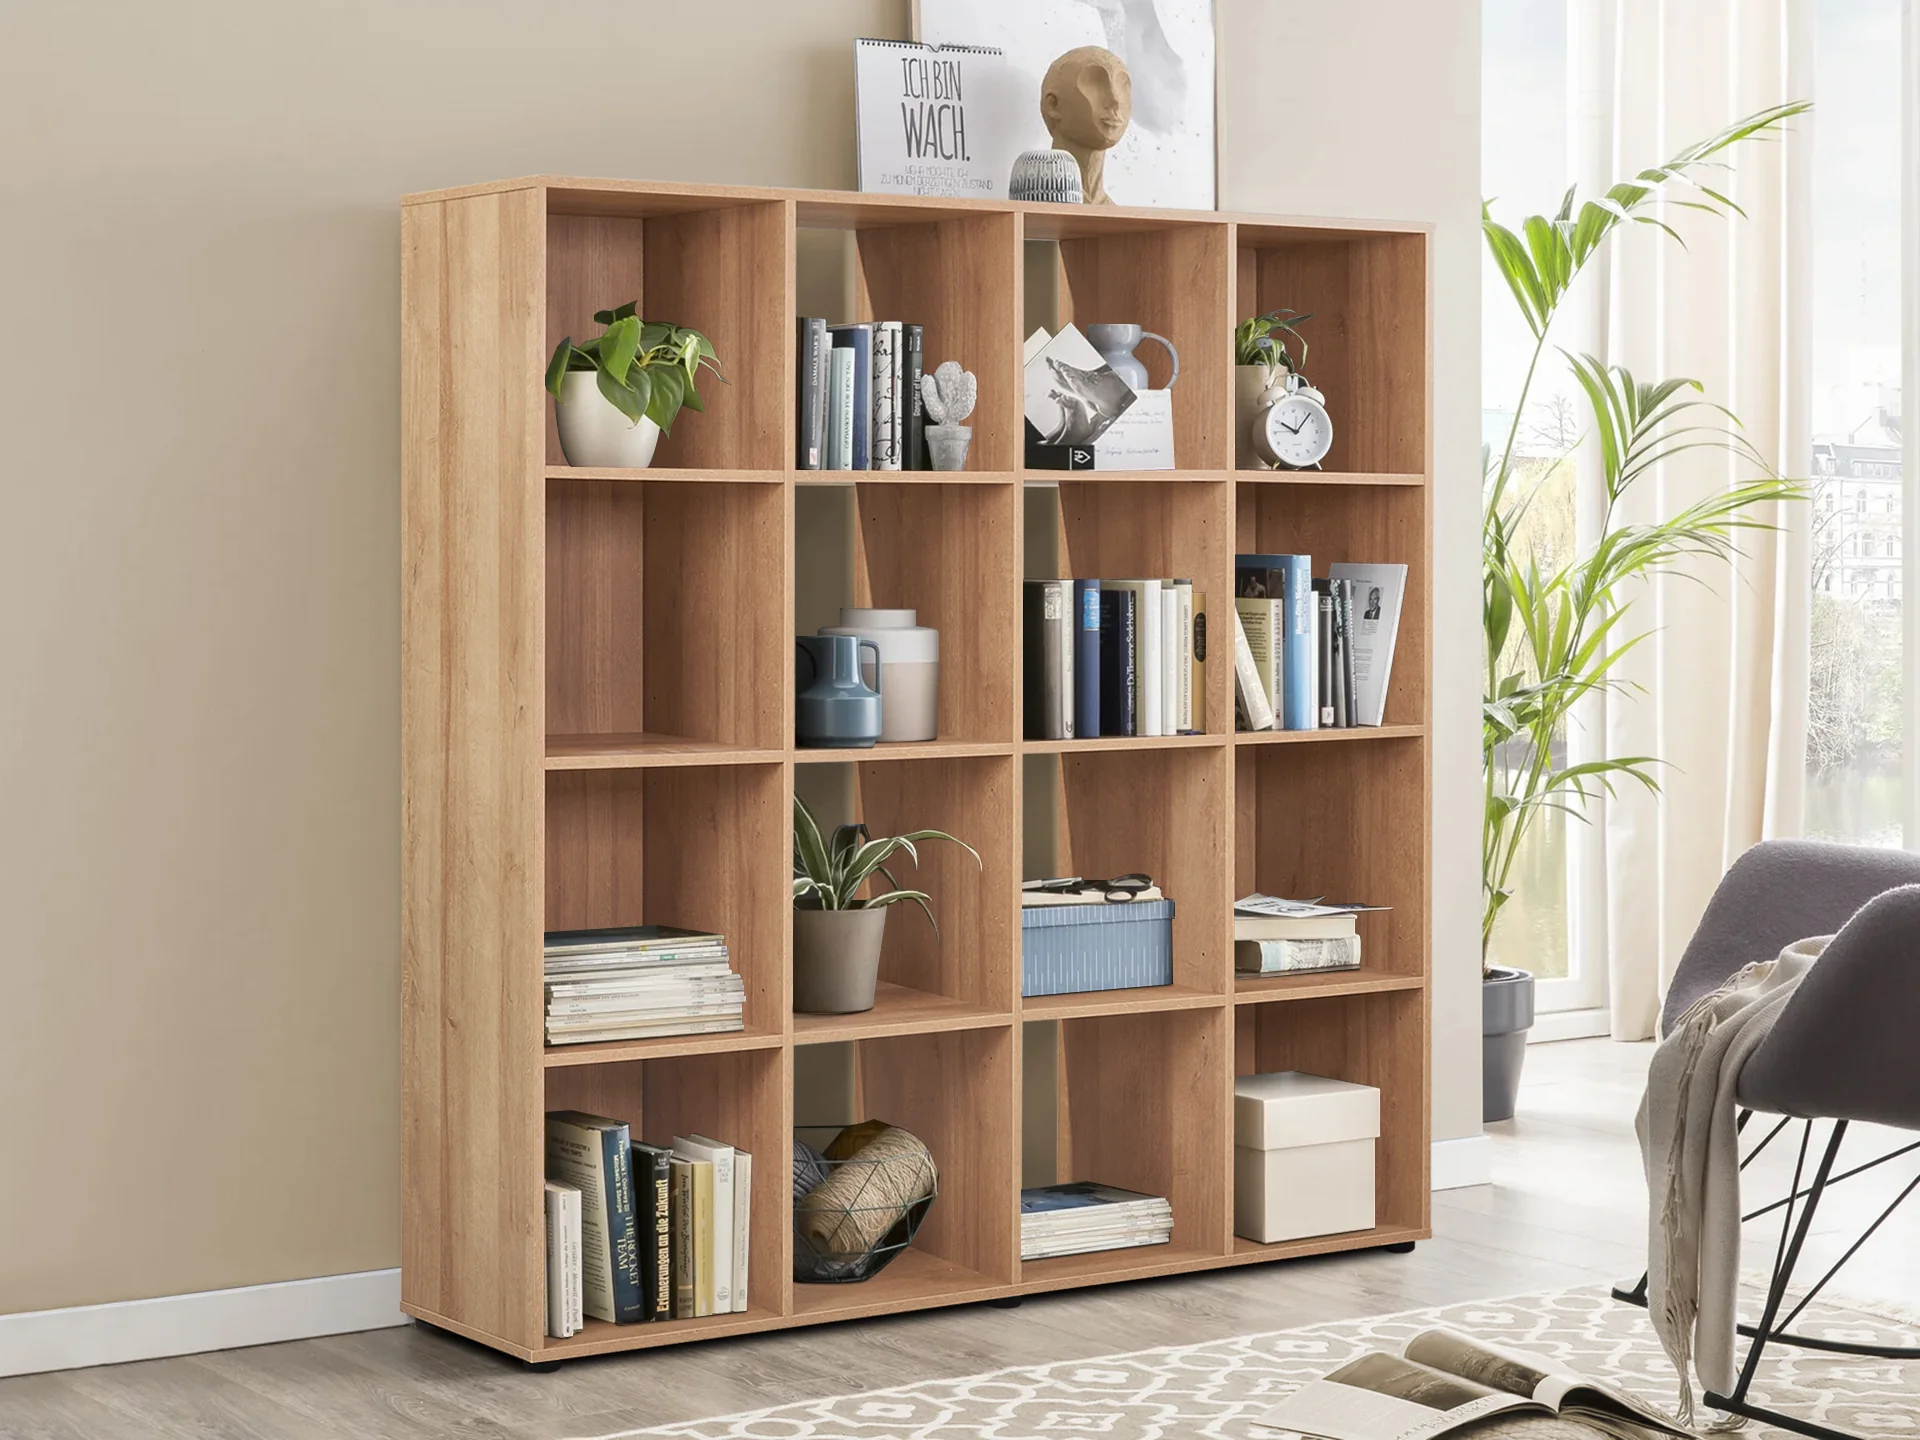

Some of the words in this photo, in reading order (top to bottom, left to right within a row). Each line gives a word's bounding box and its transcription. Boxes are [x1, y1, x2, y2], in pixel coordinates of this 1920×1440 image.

[901, 58, 930, 100] ICH
[933, 60, 962, 101] BIN
[901, 101, 971, 162] WACH.
[880, 173, 892, 185] ZU
[961, 178, 994, 191] ZUSTAND
[655, 1178, 669, 1217] Zukunft
[623, 1213, 635, 1238] THE
[656, 1217, 669, 1234] die
[657, 1235, 669, 1247] an
[616, 1236, 628, 1271] TEAM
[626, 1237, 640, 1287] ROCKET
[655, 1248, 670, 1312] Erinnerungen
